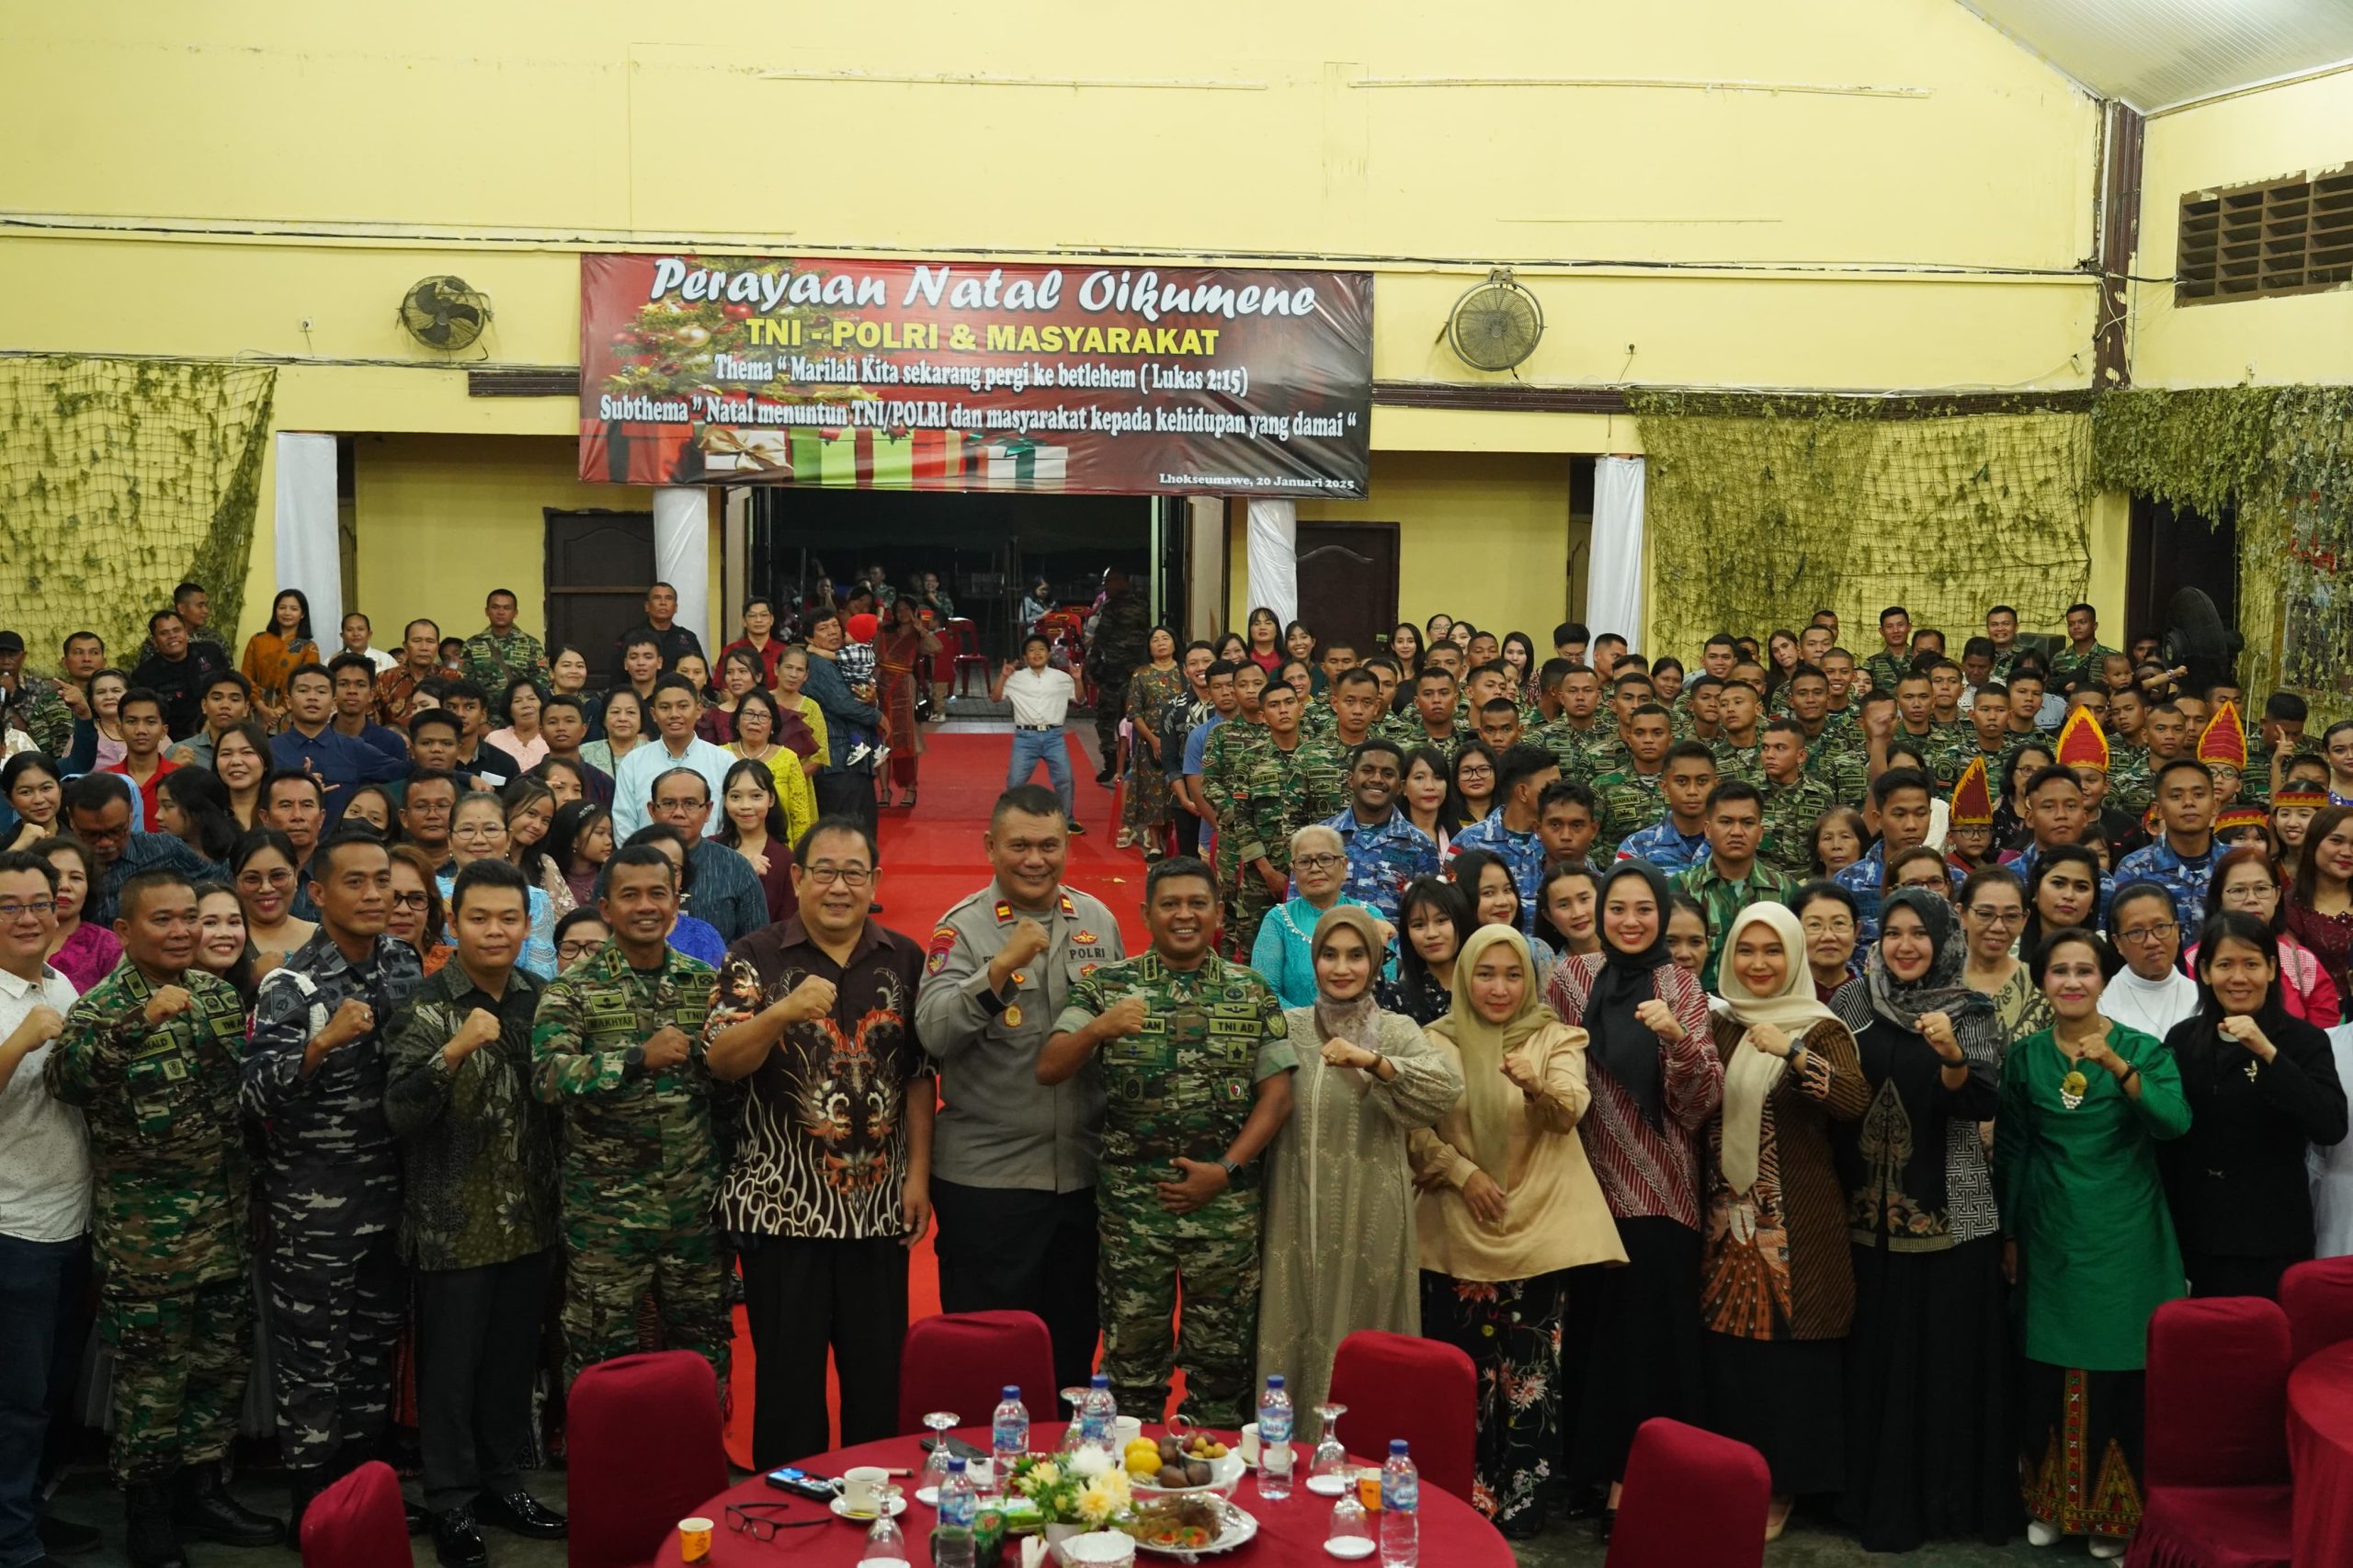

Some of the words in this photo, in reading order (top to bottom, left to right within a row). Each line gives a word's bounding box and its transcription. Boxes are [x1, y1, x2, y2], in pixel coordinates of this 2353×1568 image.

[651, 257, 886, 312] Perayaan
[904, 265, 1063, 311] Natal
[1078, 269, 1317, 322] Oikumene
[745, 317, 801, 347] TNI
[832, 321, 938, 350] POLRI
[949, 324, 976, 351] &
[986, 324, 1220, 355] MASYARAKAT
[714, 353, 773, 381] Thema
[860, 355, 899, 383] Kita
[903, 359, 981, 392] sekarang
[983, 361, 1029, 393] pergi
[1032, 361, 1054, 387] ke
[1057, 361, 1136, 389] betlehem
[1152, 363, 1204, 390] Lukas
[1206, 366, 1248, 398] 2:15)
[600, 393, 688, 421] Subthema
[757, 402, 847, 426] menuntun
[851, 399, 948, 431] TNI/POLRI
[950, 402, 983, 428] dan
[986, 404, 1086, 434] masyarakat
[1090, 404, 1152, 437] kepada
[1155, 405, 1245, 438] kehidupan
[1249, 415, 1290, 441] yang
[1292, 410, 1344, 437] damai
[1159, 473, 1254, 487] Lhokseumawe,
[1256, 477, 1271, 486] 20
[1274, 476, 1323, 488] Januari
[1324, 479, 1355, 490] 2025
[1069, 947, 1107, 960] POLRI
[1142, 1021, 1162, 1030] AN
[1218, 1021, 1236, 1031] TNI
[1239, 1023, 1255, 1033] AD
